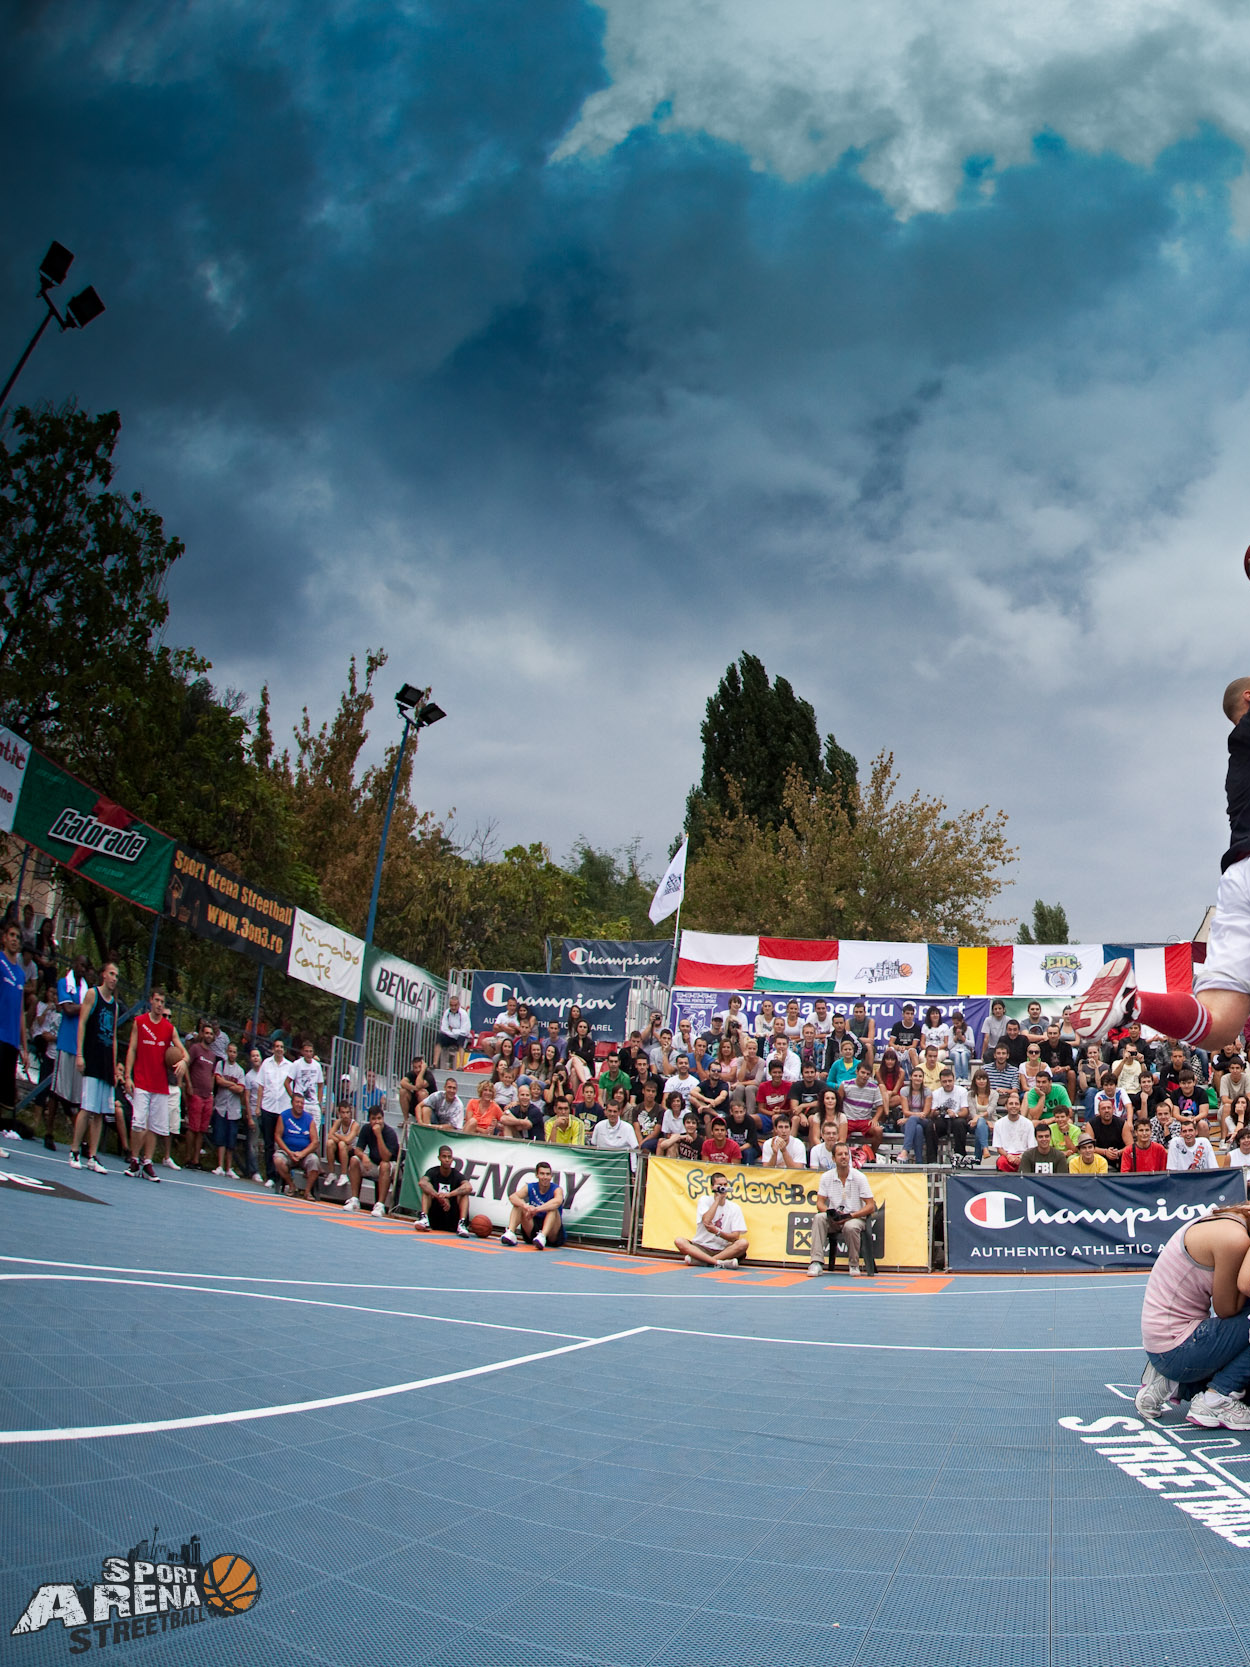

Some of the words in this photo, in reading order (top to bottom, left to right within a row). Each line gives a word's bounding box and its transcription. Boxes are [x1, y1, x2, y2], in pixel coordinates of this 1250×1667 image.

[50, 808, 147, 861] Gatorade
[175, 850, 205, 882] Sport
[208, 869, 239, 900] Arena
[207, 904, 283, 954] www.3on3.ro
[295, 947, 332, 981] Café
[569, 947, 662, 972] Champion
[1045, 955, 1077, 970] EDC
[376, 967, 437, 1015] BENGAY
[483, 983, 616, 1017] Champion
[1035, 1162, 1053, 1174] FBI
[964, 1190, 1219, 1237] Champion
[971, 1246, 1066, 1257] AUTHENTIC
[1071, 1243, 1152, 1256] ATHLETIC
